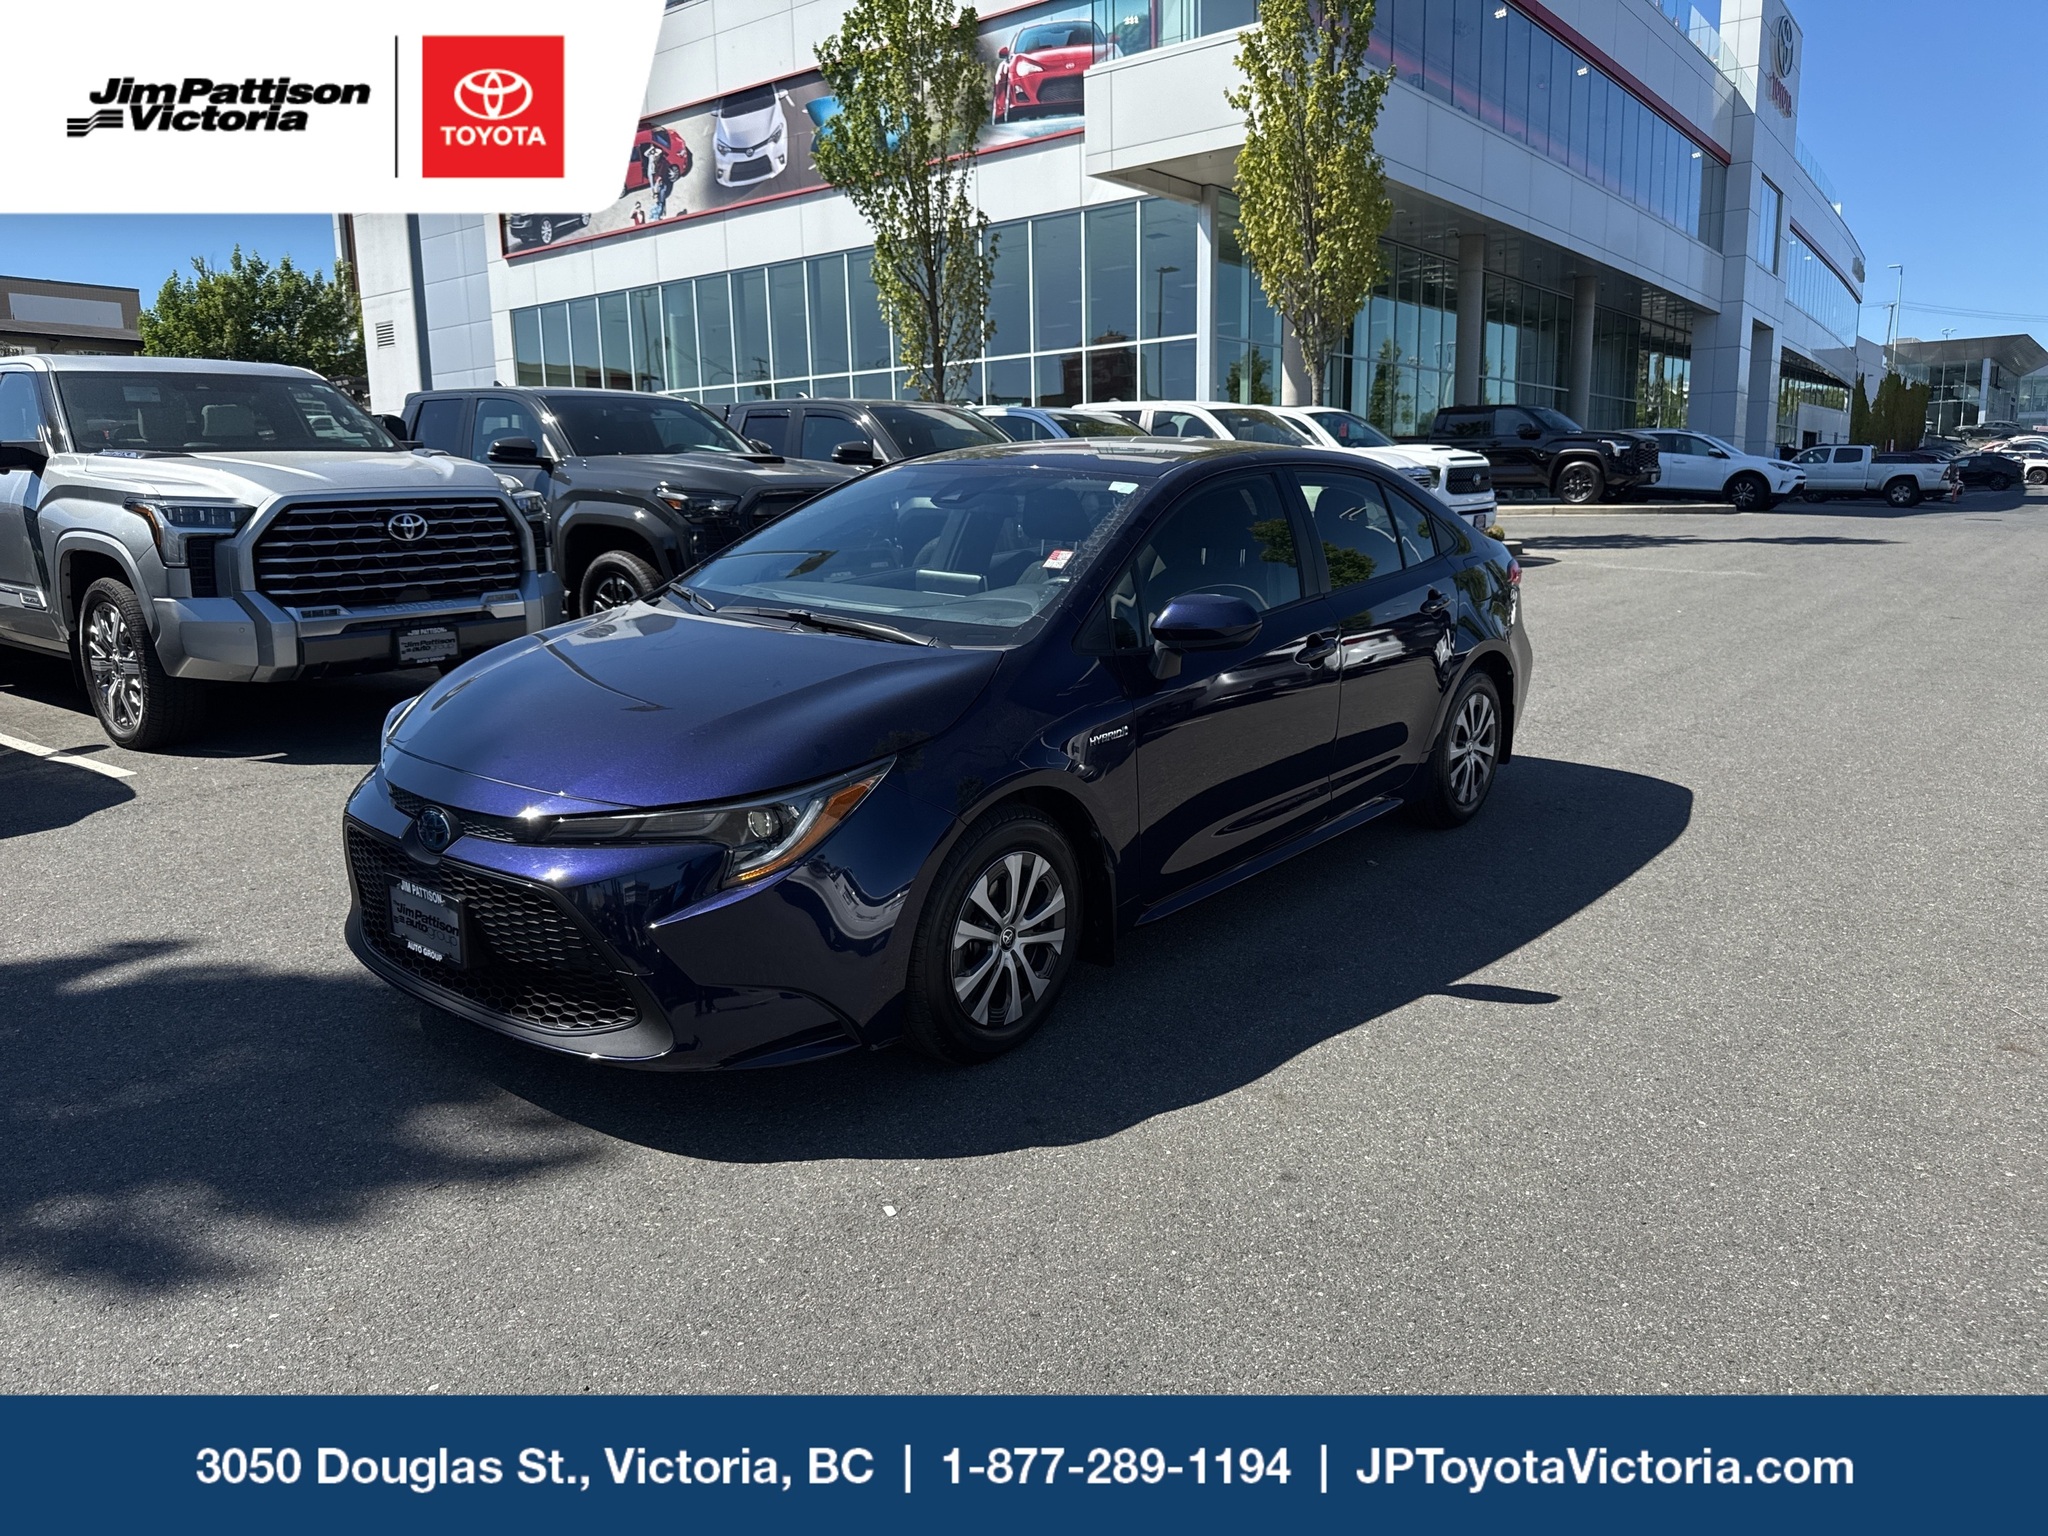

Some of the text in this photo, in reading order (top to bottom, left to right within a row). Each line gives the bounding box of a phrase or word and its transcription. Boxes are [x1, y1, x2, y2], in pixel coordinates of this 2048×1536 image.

[377, 600, 457, 613] TUNDRA
[1089, 729, 1122, 746] HYBRID
[401, 880, 443, 904] JIM PATTISON
[407, 941, 443, 962] AUTO GROUP
